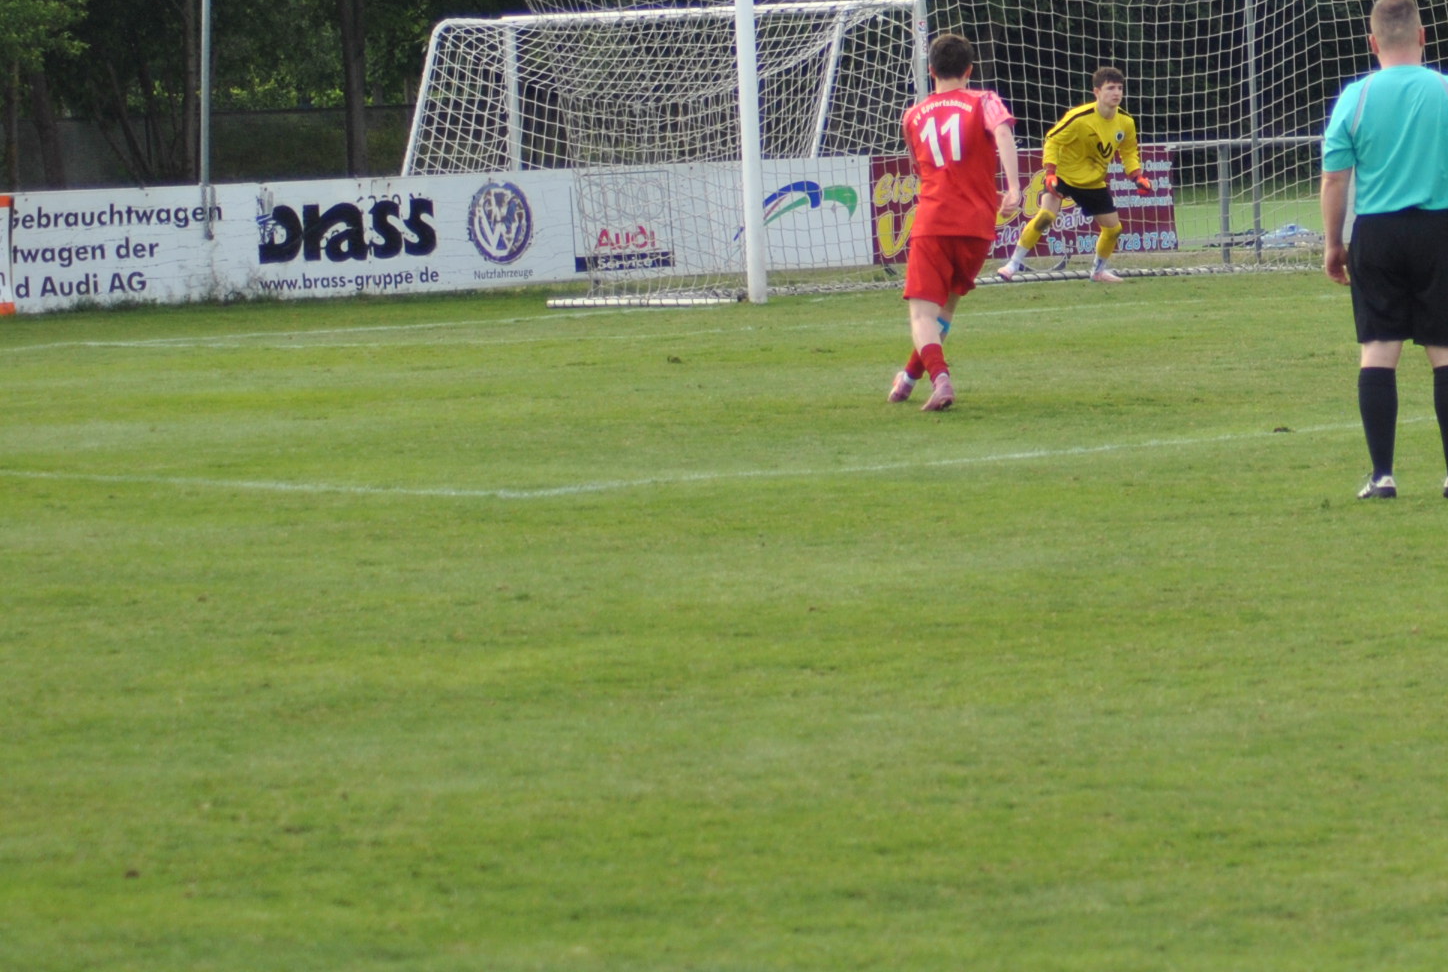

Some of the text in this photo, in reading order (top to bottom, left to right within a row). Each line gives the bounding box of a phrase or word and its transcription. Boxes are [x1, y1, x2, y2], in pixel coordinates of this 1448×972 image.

[919, 113, 961, 167] 11
[115, 236, 159, 259] der
[40, 273, 99, 298] Audi
[108, 271, 147, 294] AG
[473, 268, 534, 280] Nutzfahrzeuge
